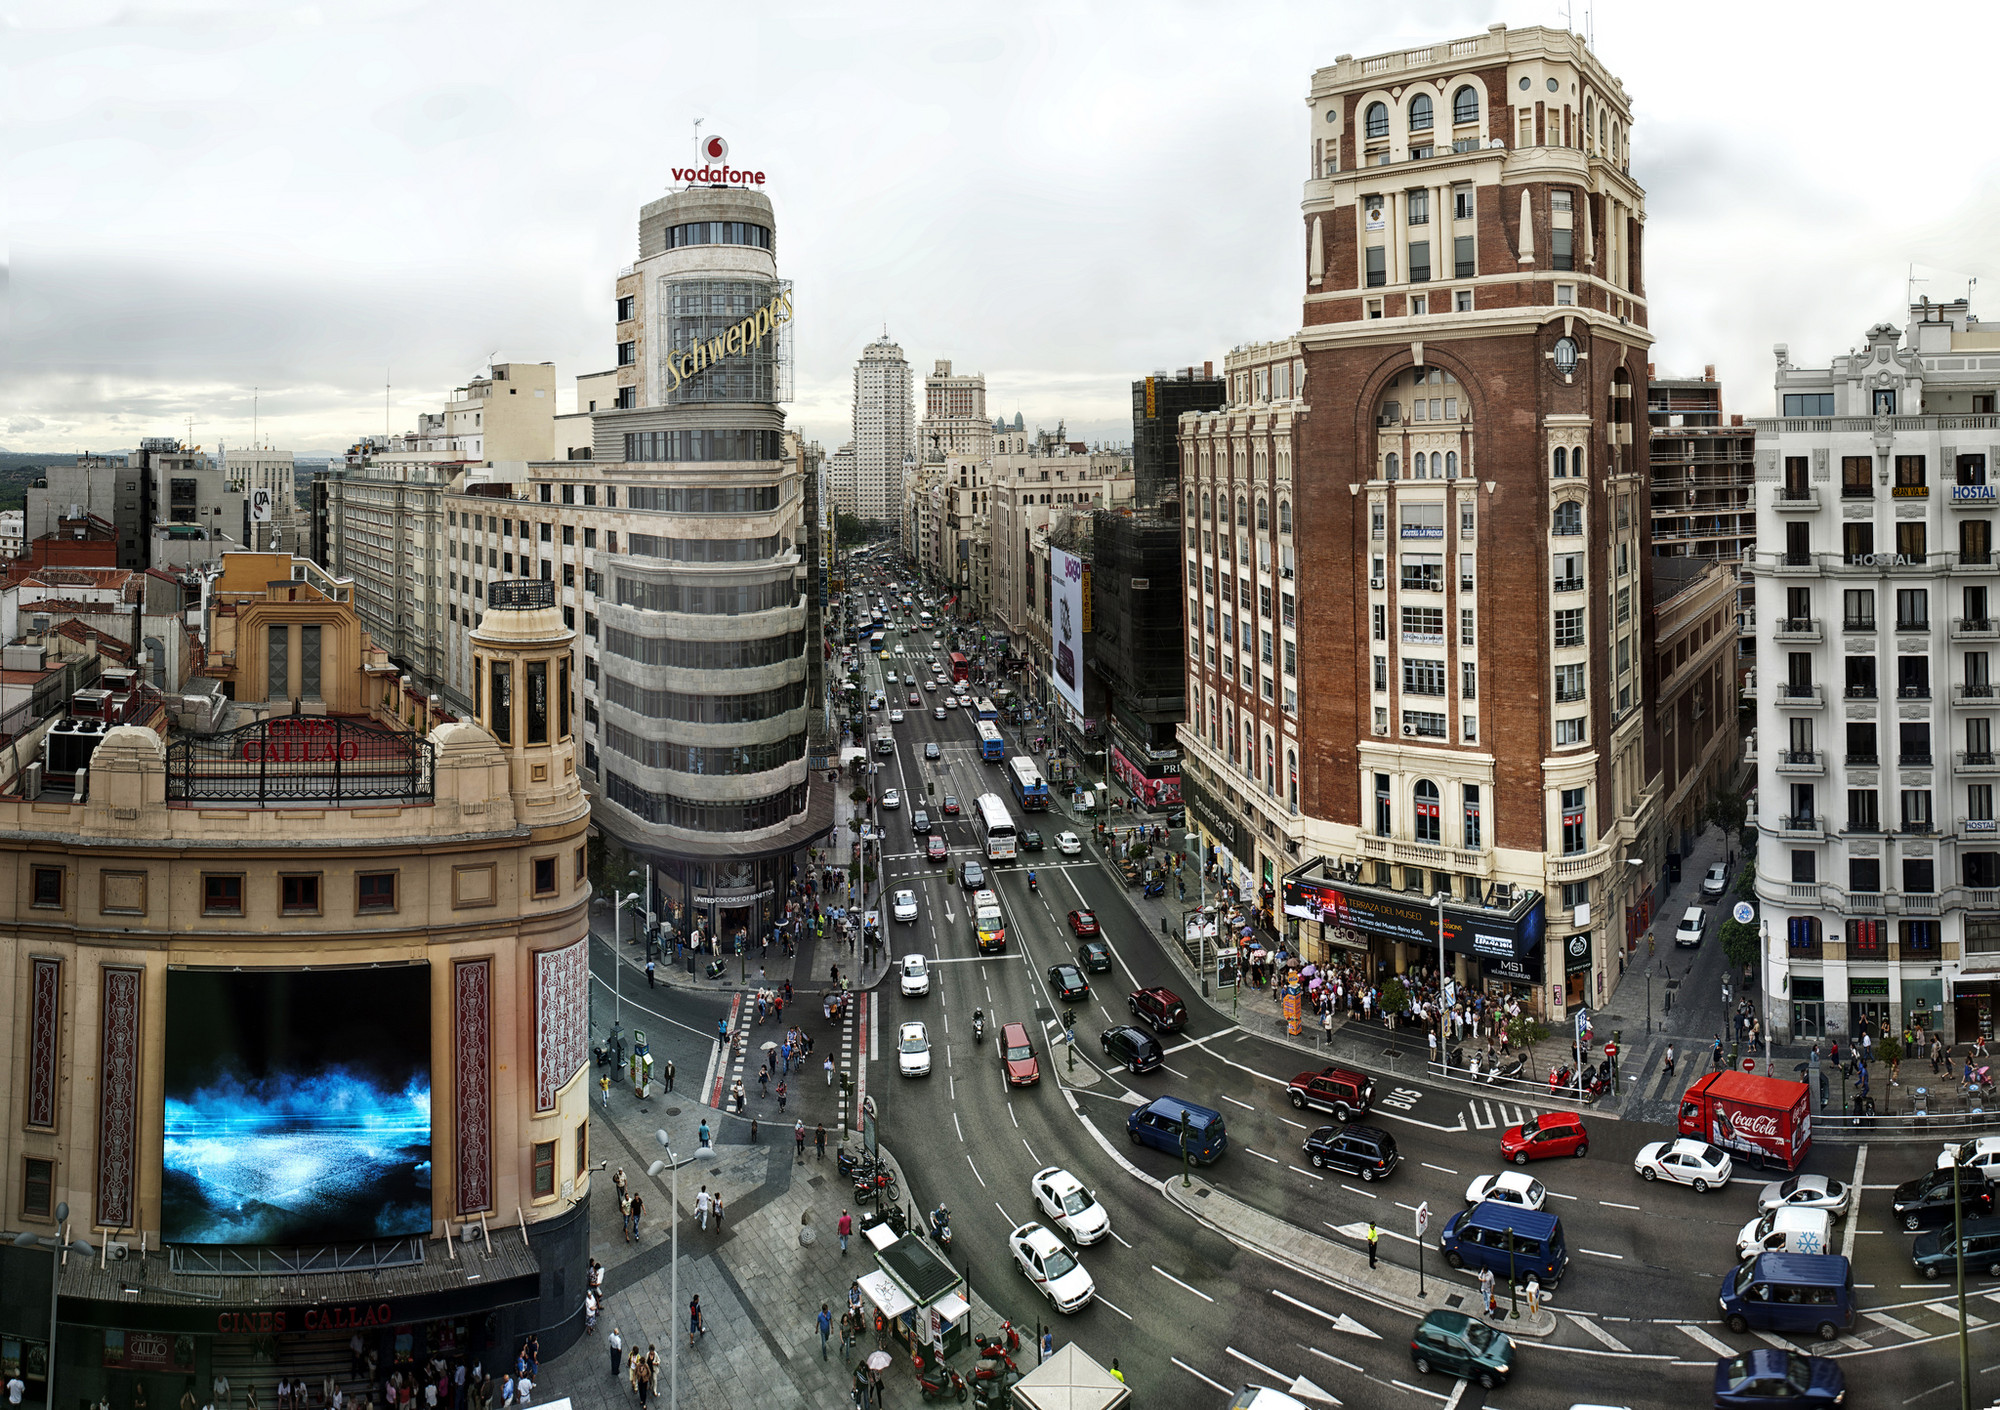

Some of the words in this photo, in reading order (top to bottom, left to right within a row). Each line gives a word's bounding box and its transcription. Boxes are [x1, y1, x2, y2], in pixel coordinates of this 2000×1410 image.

[671, 165, 766, 185] vodafone
[666, 288, 793, 393] Schweppes
[1909, 487, 1920, 497] VIA
[1953, 486, 1996, 499] HOSTAL
[1419, 529, 1426, 537] LA
[1852, 554, 1916, 566] HOSTAL
[1065, 556, 1081, 583] yoigo
[268, 719, 334, 736] CINES
[243, 741, 358, 762] CALLAO
[1966, 821, 1996, 829] HOSTAL
[694, 896, 715, 904] UNITED
[749, 888, 775, 901] BENETTON
[1338, 897, 1348, 905] LA
[1348, 898, 1380, 913] TERRAZA
[1380, 905, 1395, 916] DEL
[1395, 908, 1422, 921] MUSEO
[1501, 960, 1523, 973] MS1
[1381, 1087, 1423, 1111] BUS
[1730, 1110, 1779, 1136] Coca-Cola
[217, 1311, 288, 1333] CINES
[304, 1303, 392, 1331] CALLAO
[131, 1341, 168, 1356] CALLAO
